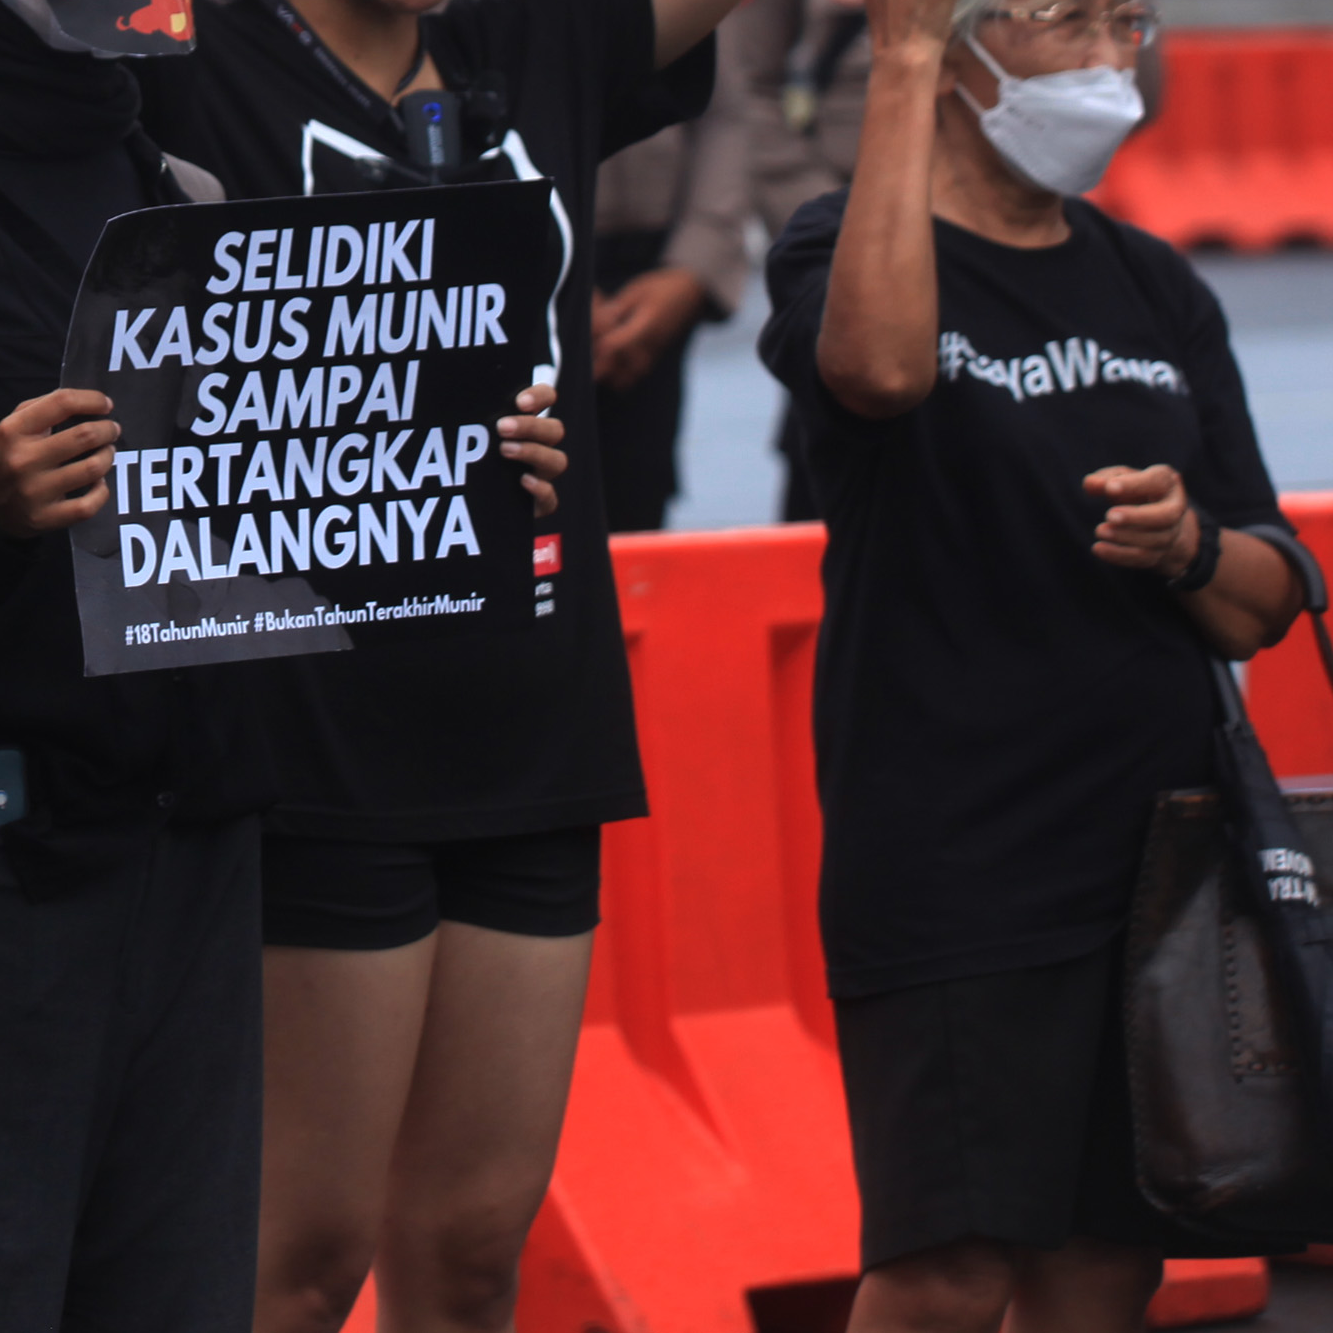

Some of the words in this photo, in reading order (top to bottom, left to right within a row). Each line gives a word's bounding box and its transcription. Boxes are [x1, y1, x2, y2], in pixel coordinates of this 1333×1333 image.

[206, 219, 434, 294] SELIDIKI
[109, 298, 311, 371] KASUS
[323, 284, 507, 357] MUNIR
[191, 361, 419, 436] SAMPAI
[114, 425, 488, 514] TERTANGKAP
[120, 495, 480, 587] DALANGNYA
[125, 614, 250, 645] #18TahunMunir
[254, 592, 485, 632] #BukanTahunTerakhirMunir
